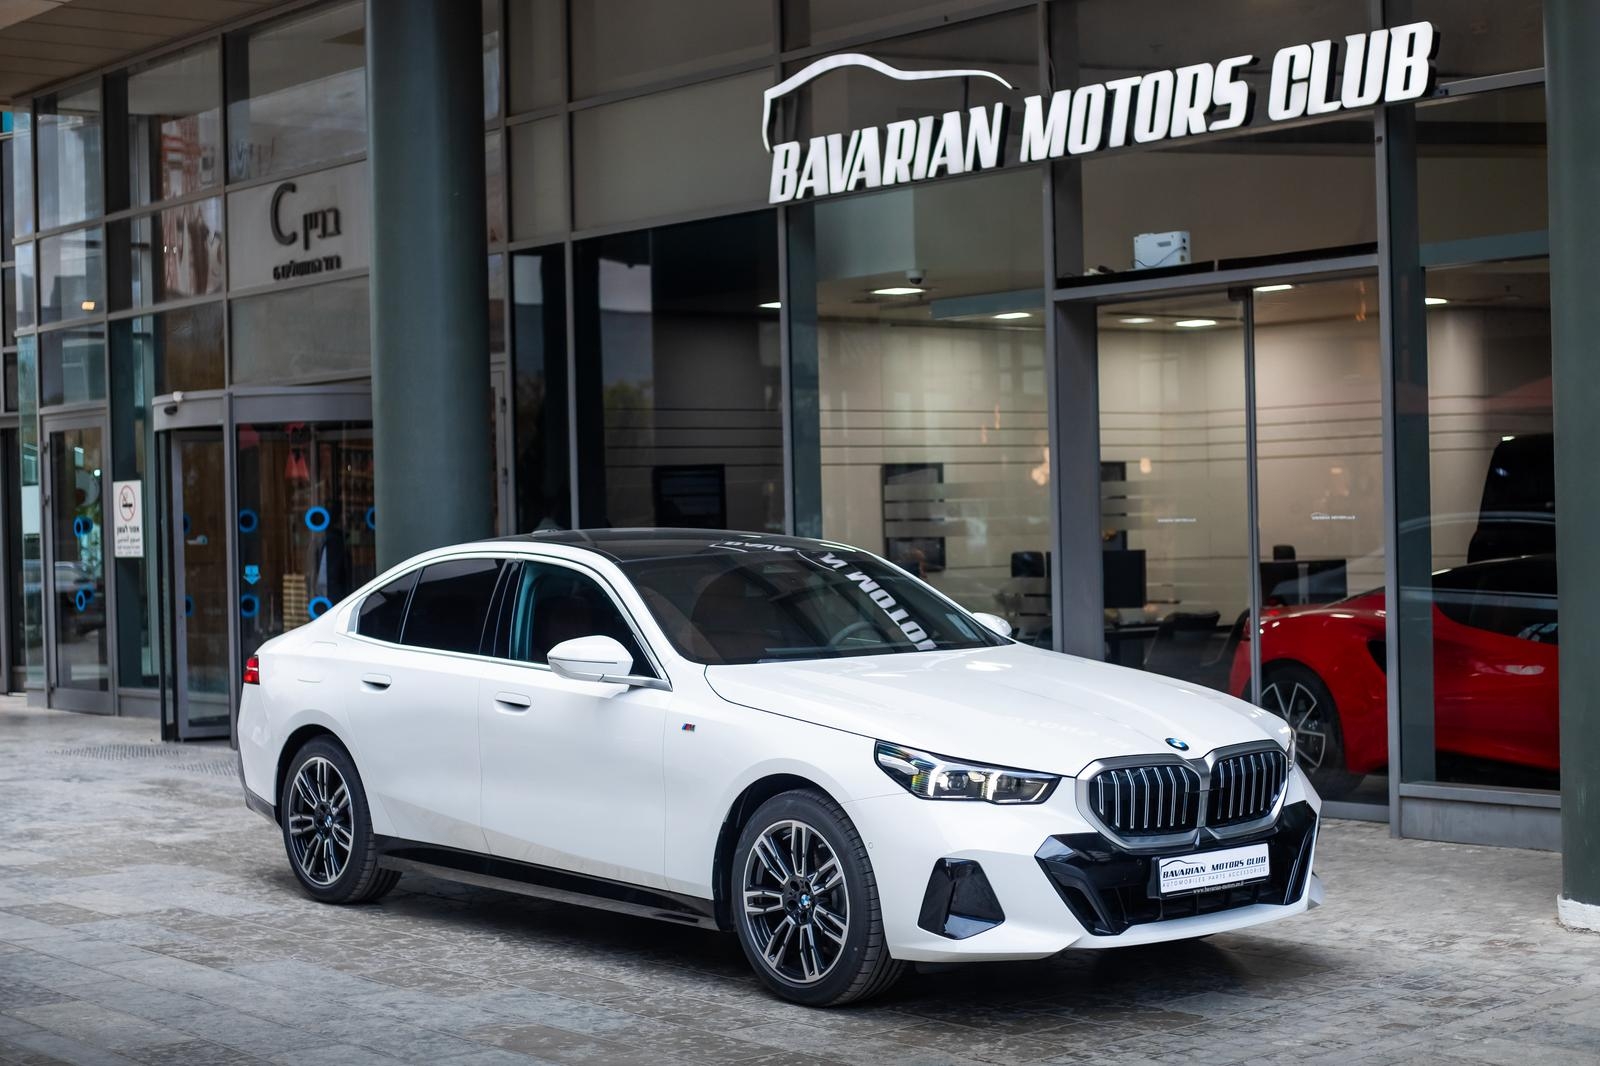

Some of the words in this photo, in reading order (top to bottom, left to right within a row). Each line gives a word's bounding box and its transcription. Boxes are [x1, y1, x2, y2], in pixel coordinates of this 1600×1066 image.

[768, 101, 1005, 205] BAVARIAN
[1019, 55, 1254, 164] MOTORS
[1268, 20, 1433, 121] CLUB
[271, 182, 297, 246] C
[303, 208, 342, 250] בניין
[1163, 866, 1206, 878] BAVARIAN
[1212, 860, 1244, 870] MOTORS
[1247, 856, 1266, 865] CLUB
